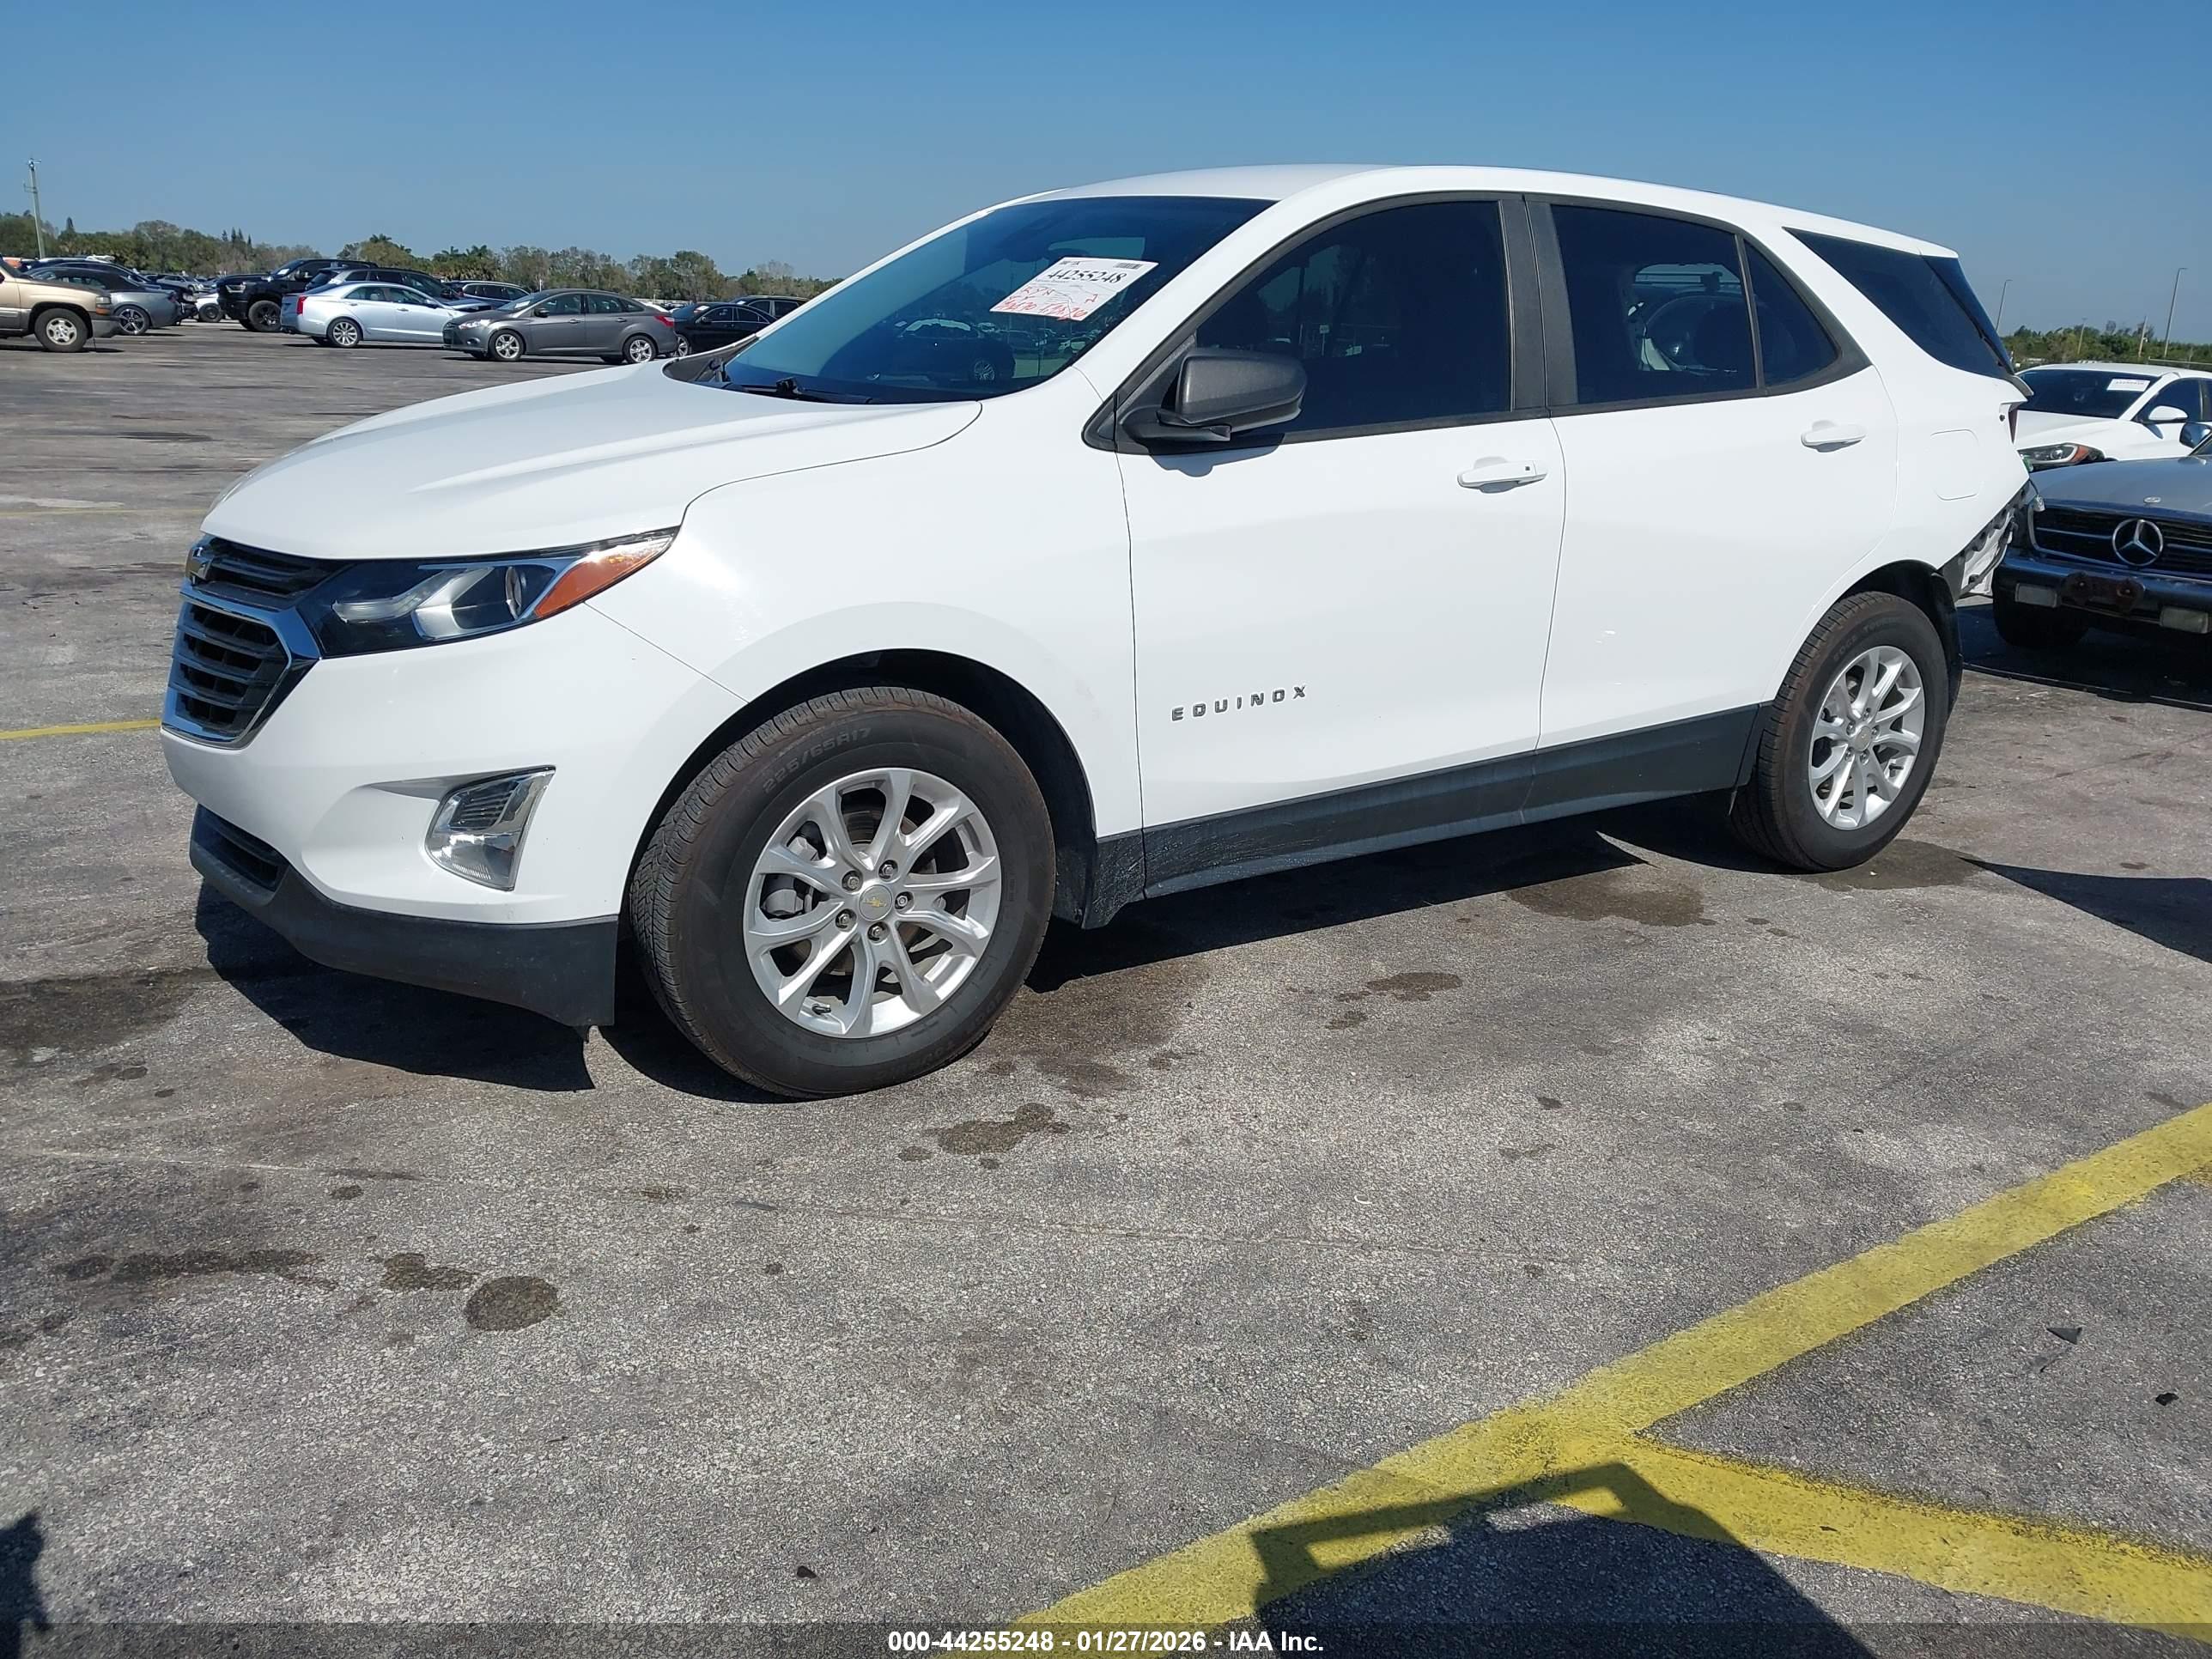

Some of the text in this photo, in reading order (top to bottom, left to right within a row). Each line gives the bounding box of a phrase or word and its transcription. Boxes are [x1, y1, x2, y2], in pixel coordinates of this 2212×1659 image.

[1047, 269, 1127, 283] 44255248
[1171, 684, 1307, 721] EQUINOX
[762, 727, 872, 794] 225/65R17
